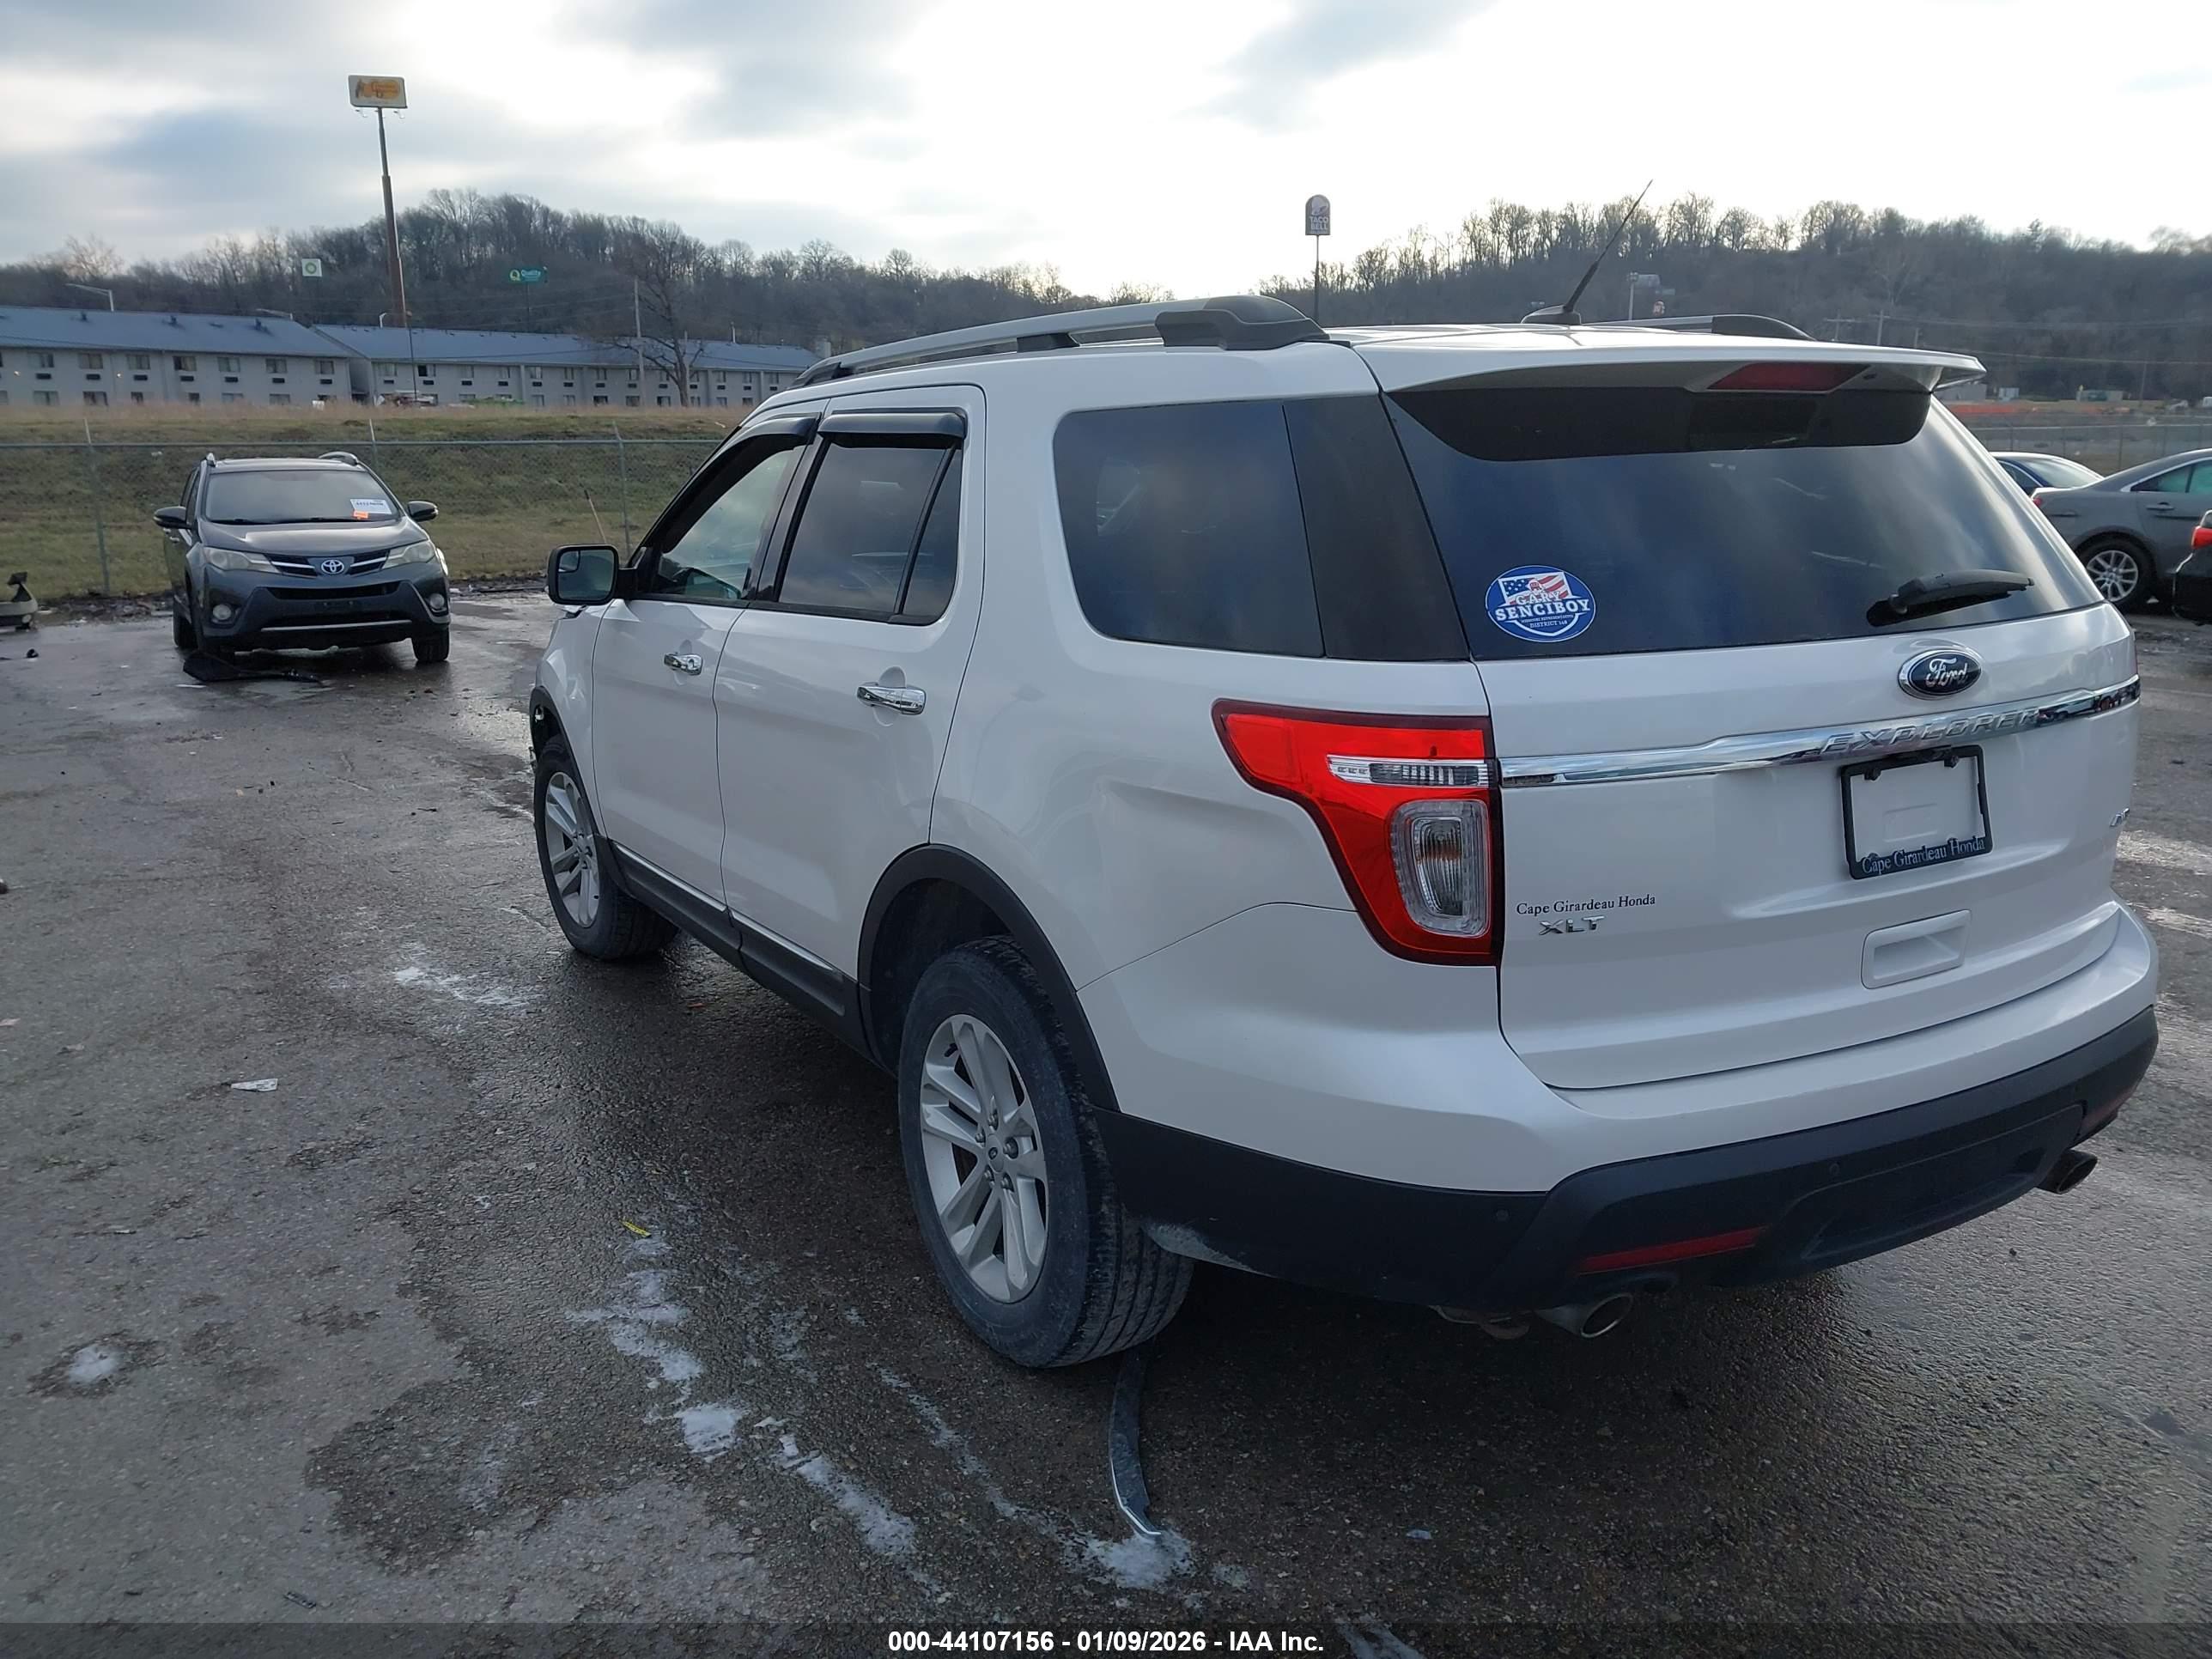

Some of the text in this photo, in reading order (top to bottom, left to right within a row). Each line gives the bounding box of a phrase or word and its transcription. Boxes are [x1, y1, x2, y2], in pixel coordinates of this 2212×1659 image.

[1516, 589, 1561, 605] GARY
[1495, 599, 1591, 621] SENCIBOY
[1529, 620, 1558, 629] DISTRICT
[1925, 657, 1968, 688] Ford
[1820, 707, 2039, 753] EXPLORER
[1862, 836, 1985, 876] Cape Girardeau Honda
[1516, 893, 1656, 917] Cape Girardeau Honda
[1538, 915, 1606, 936] XLT
